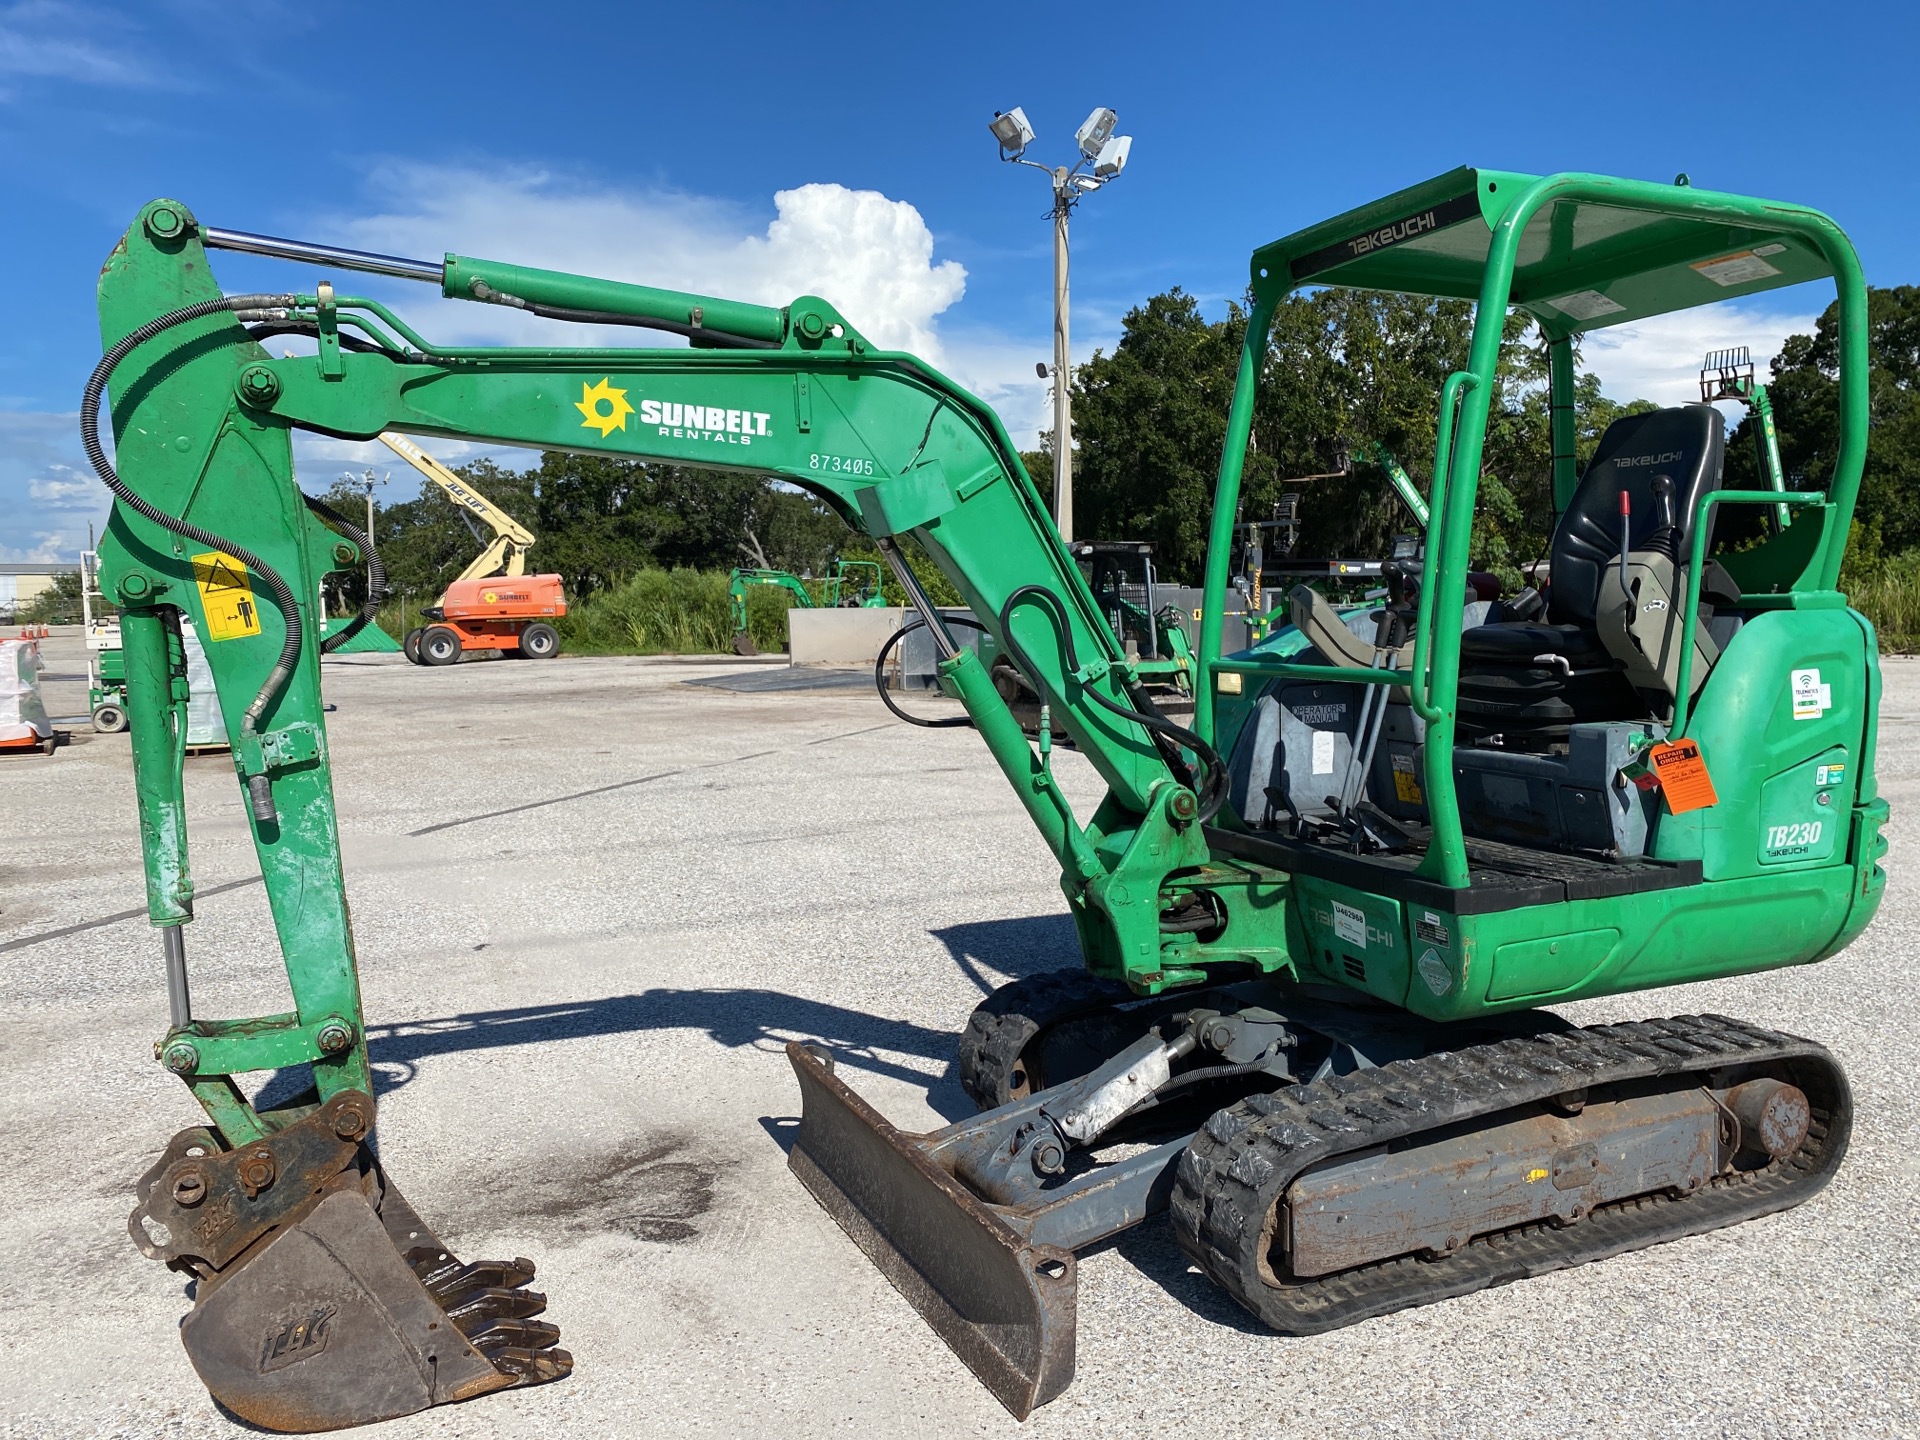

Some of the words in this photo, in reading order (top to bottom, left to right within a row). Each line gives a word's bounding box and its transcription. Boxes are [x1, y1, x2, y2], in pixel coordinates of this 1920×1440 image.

[1348, 211, 1436, 255] TAKEUCHI
[640, 399, 771, 436] SUNBELT
[658, 427, 751, 445] RENTALS
[809, 454, 873, 475] 873405
[1613, 450, 1683, 468] TAKEUCHI
[444, 483, 466, 497] JLG
[464, 496, 489, 514] LIFT
[1253, 567, 1262, 611] NATIONAL
[1292, 704, 1343, 715] OPERATORS
[1304, 713, 1336, 723] MANUAL
[1657, 748, 1684, 760] REPAIR
[1660, 754, 1686, 765] ORDER
[1766, 821, 1822, 849] TB230
[1766, 846, 1808, 857] TAKEUCHI
